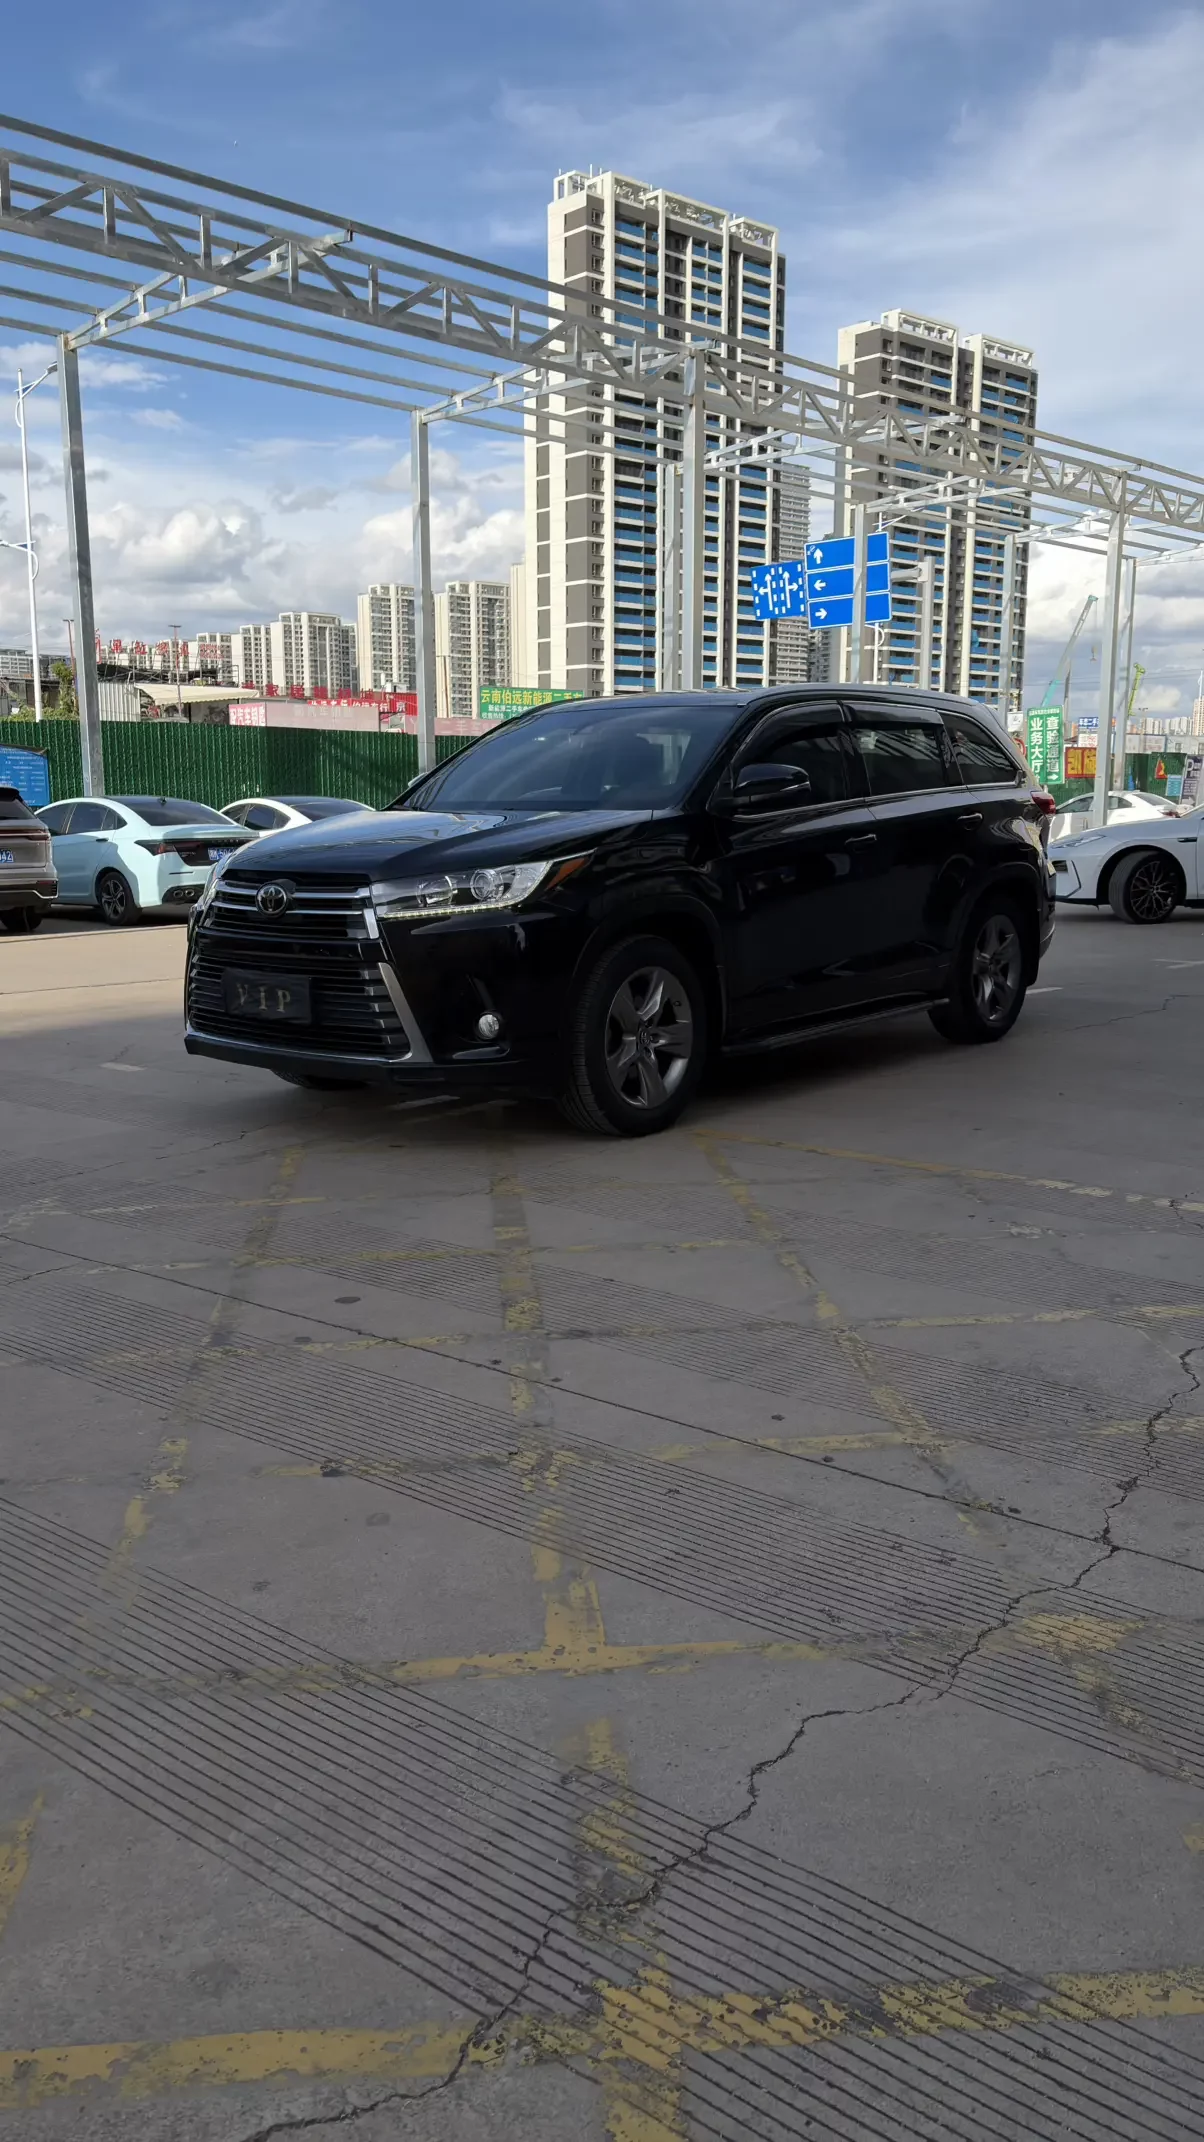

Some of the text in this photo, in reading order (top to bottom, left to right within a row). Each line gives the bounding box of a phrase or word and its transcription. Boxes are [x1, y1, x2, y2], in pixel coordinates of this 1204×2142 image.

[1030, 717, 1043, 773] 业务大厅
[1046, 716, 1060, 772] 查验通道
[236, 983, 291, 1013] VIP
